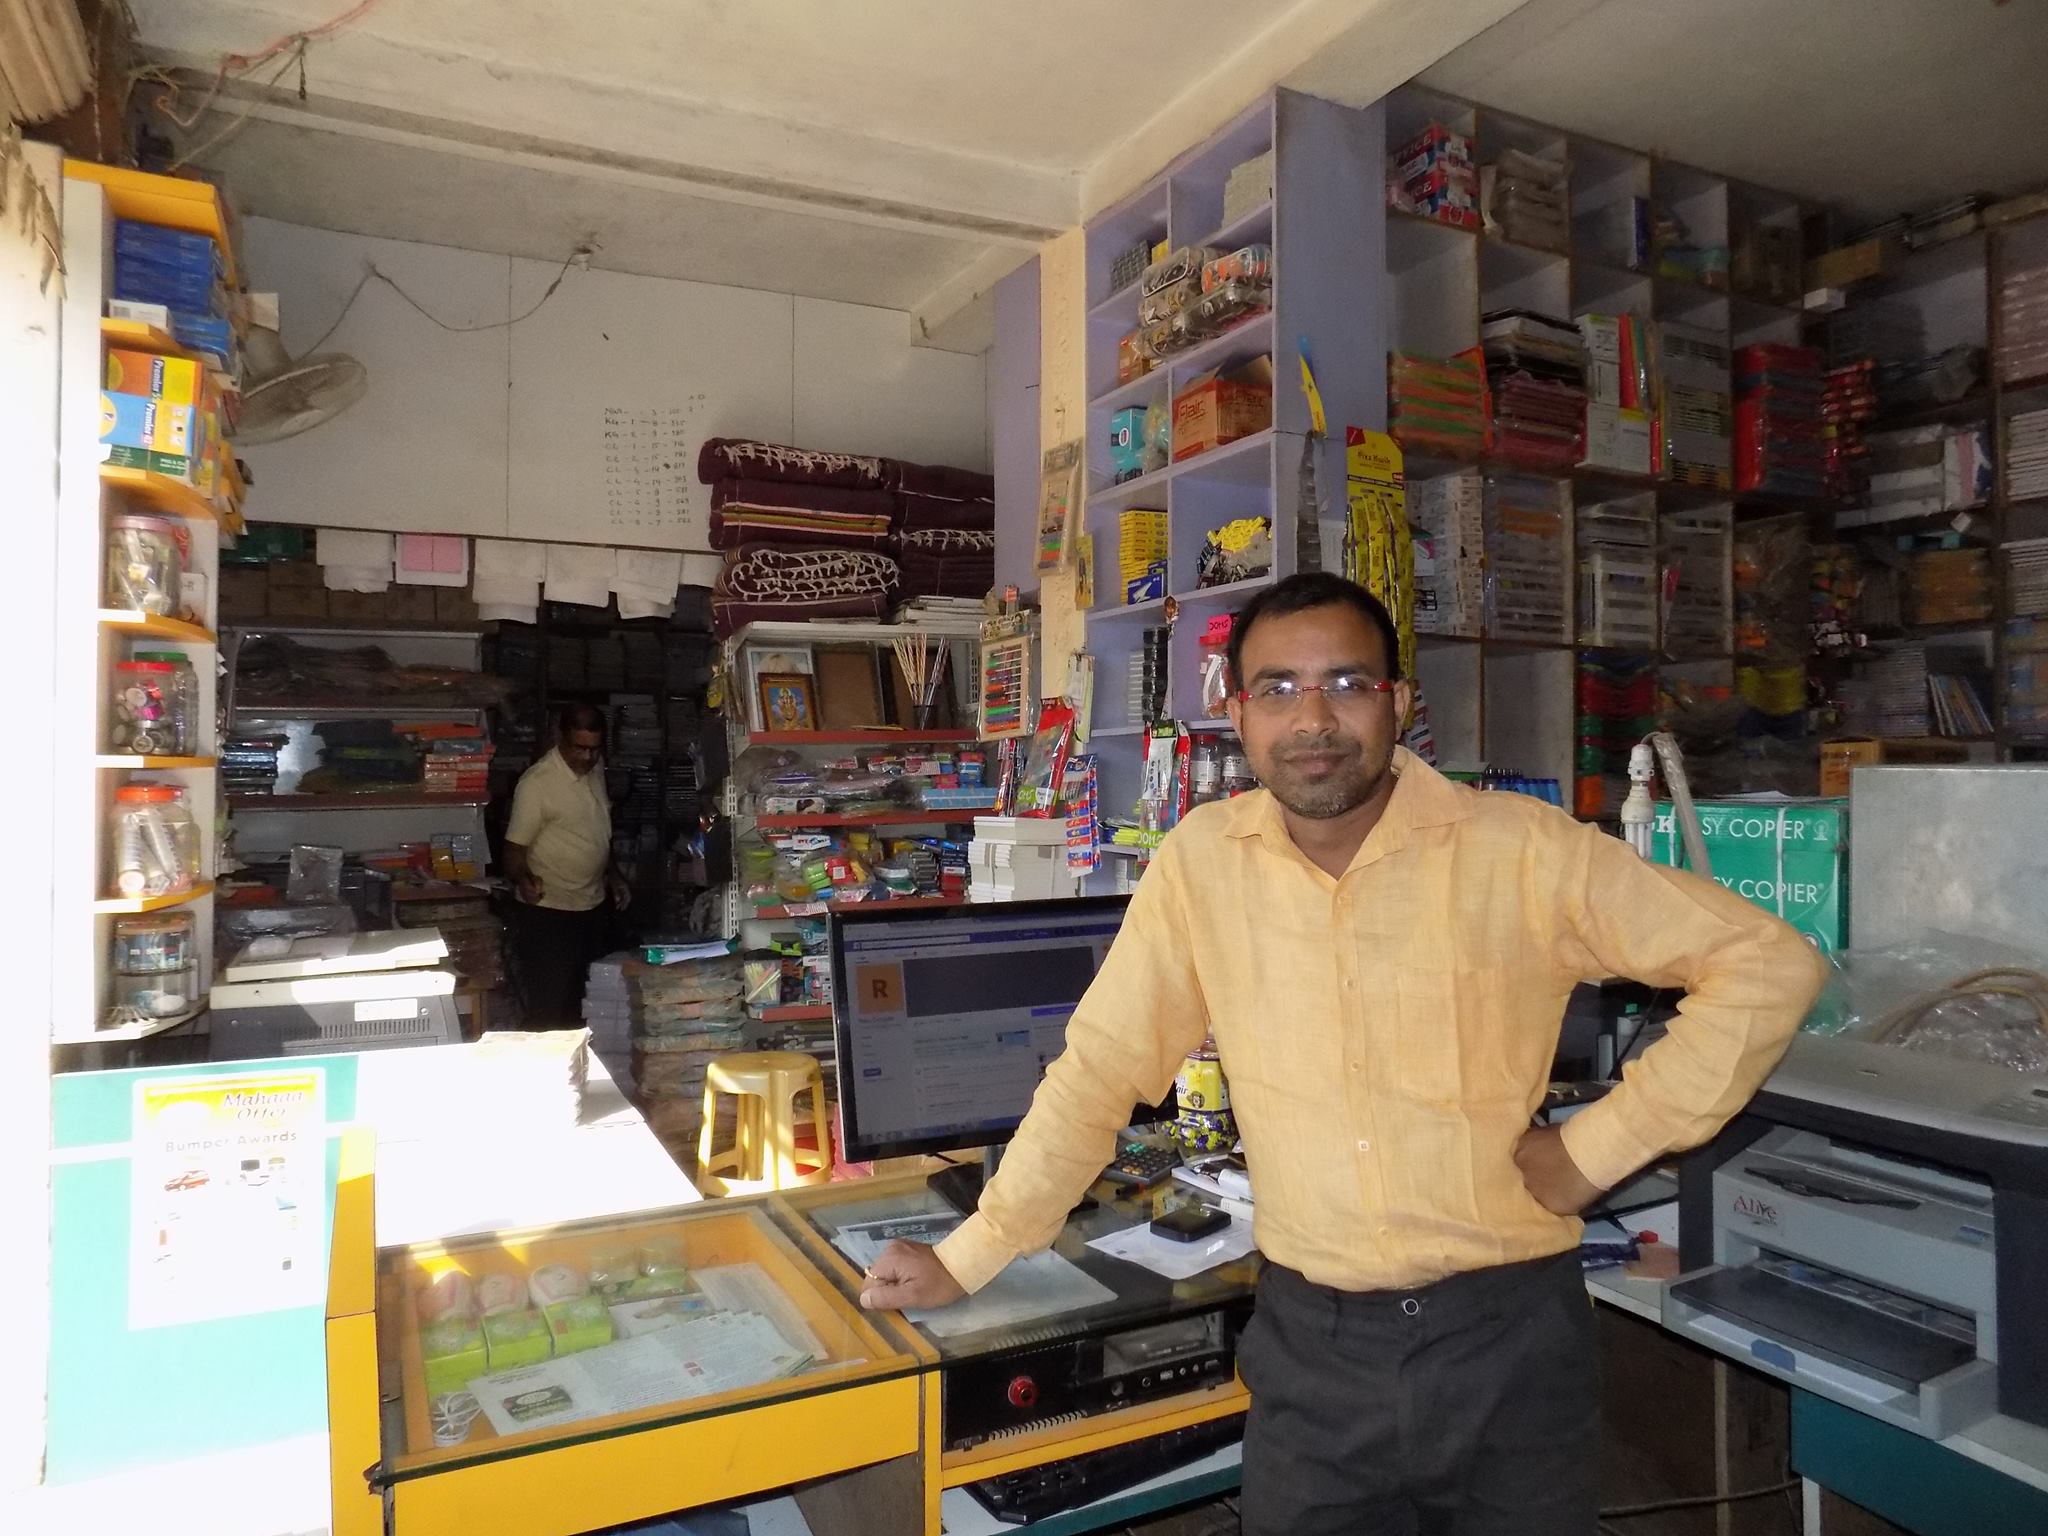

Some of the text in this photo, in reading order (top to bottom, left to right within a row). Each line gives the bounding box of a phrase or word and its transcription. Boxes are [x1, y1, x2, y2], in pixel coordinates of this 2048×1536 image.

[1729, 818, 1805, 840] COPER
[871, 979, 888, 998] R
[166, 1131, 297, 1153] Bumper Awards
